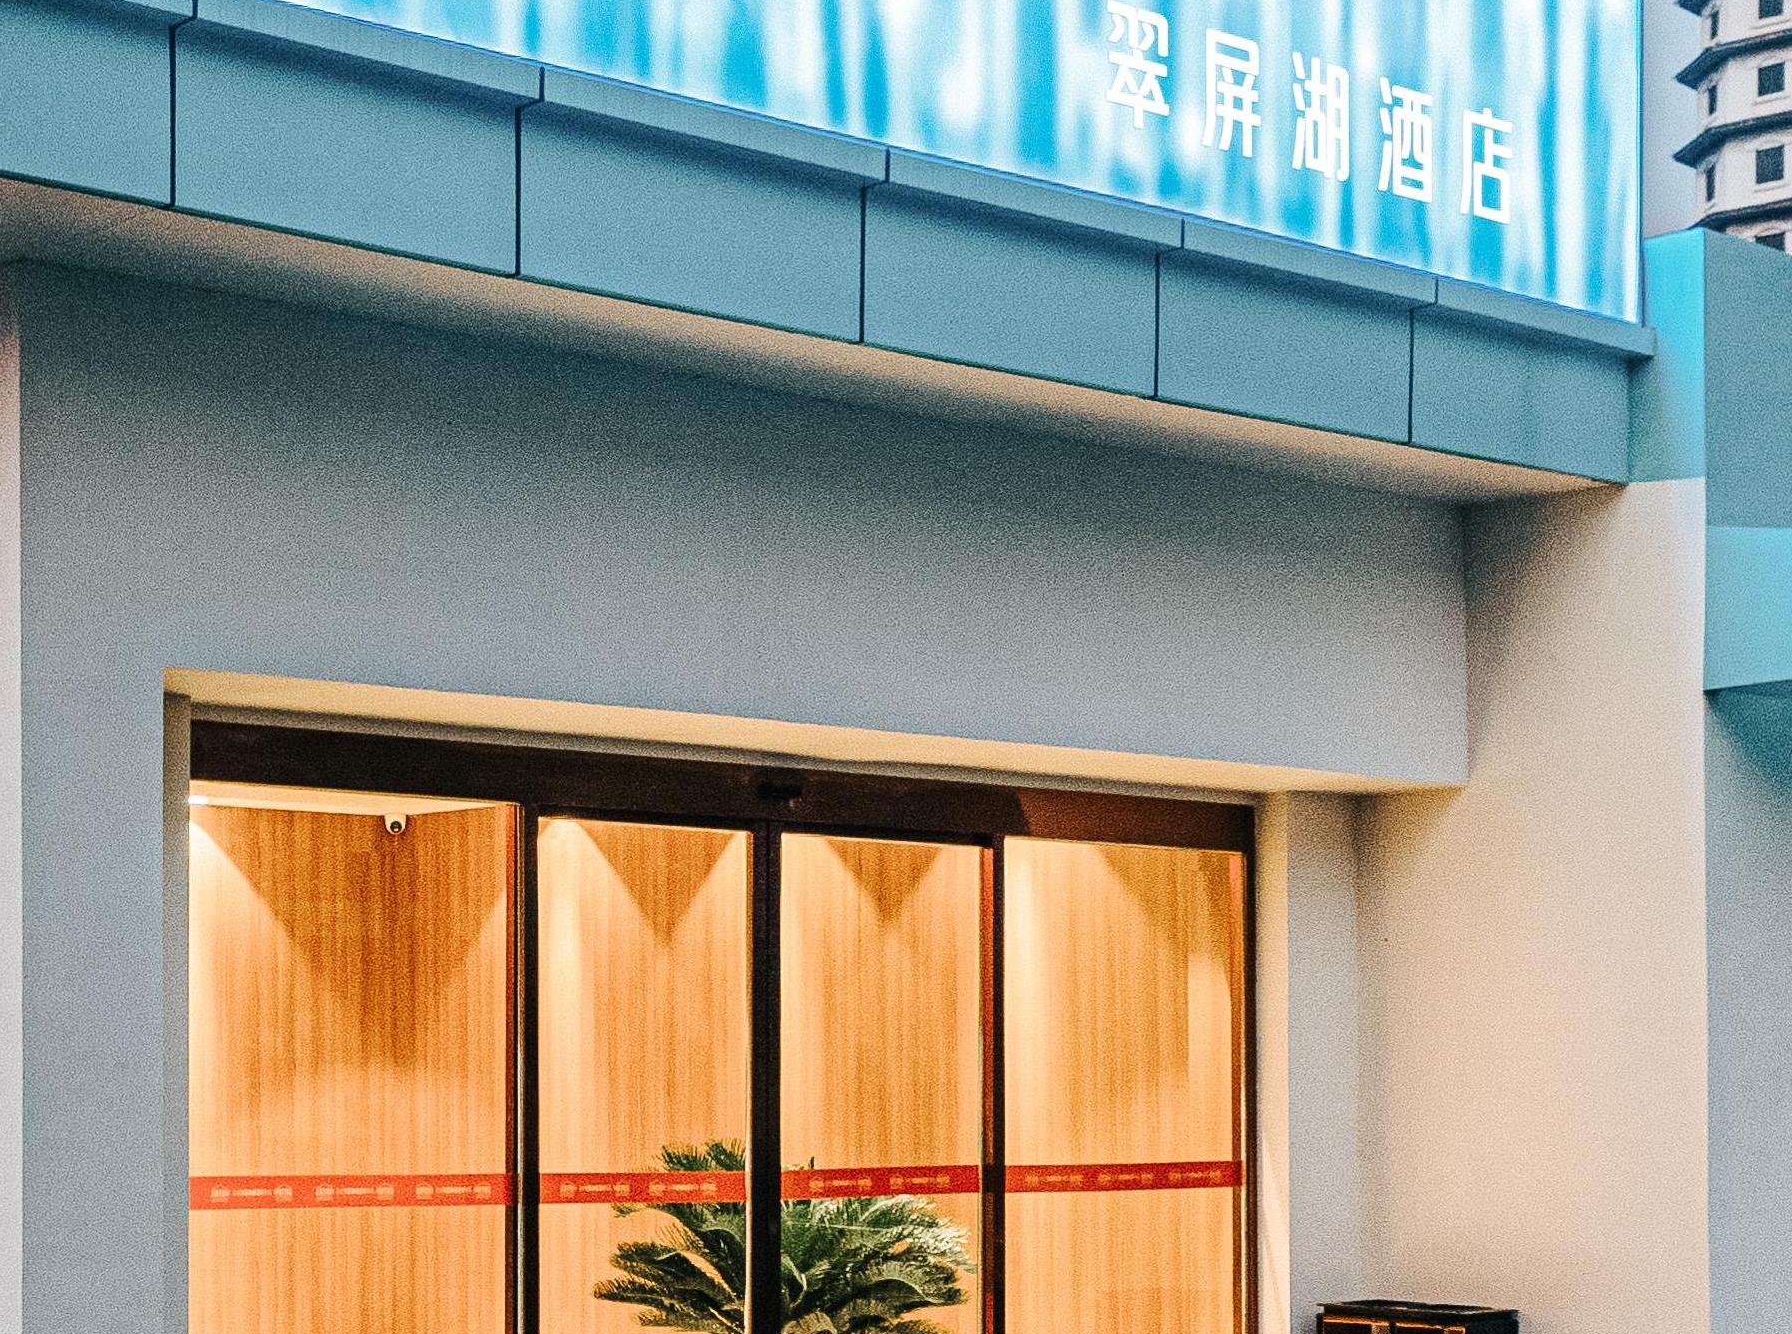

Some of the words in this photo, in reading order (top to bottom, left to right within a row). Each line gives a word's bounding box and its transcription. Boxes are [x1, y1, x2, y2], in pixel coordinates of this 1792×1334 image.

[1105, 0, 1514, 225] 翠屏湖酒店
